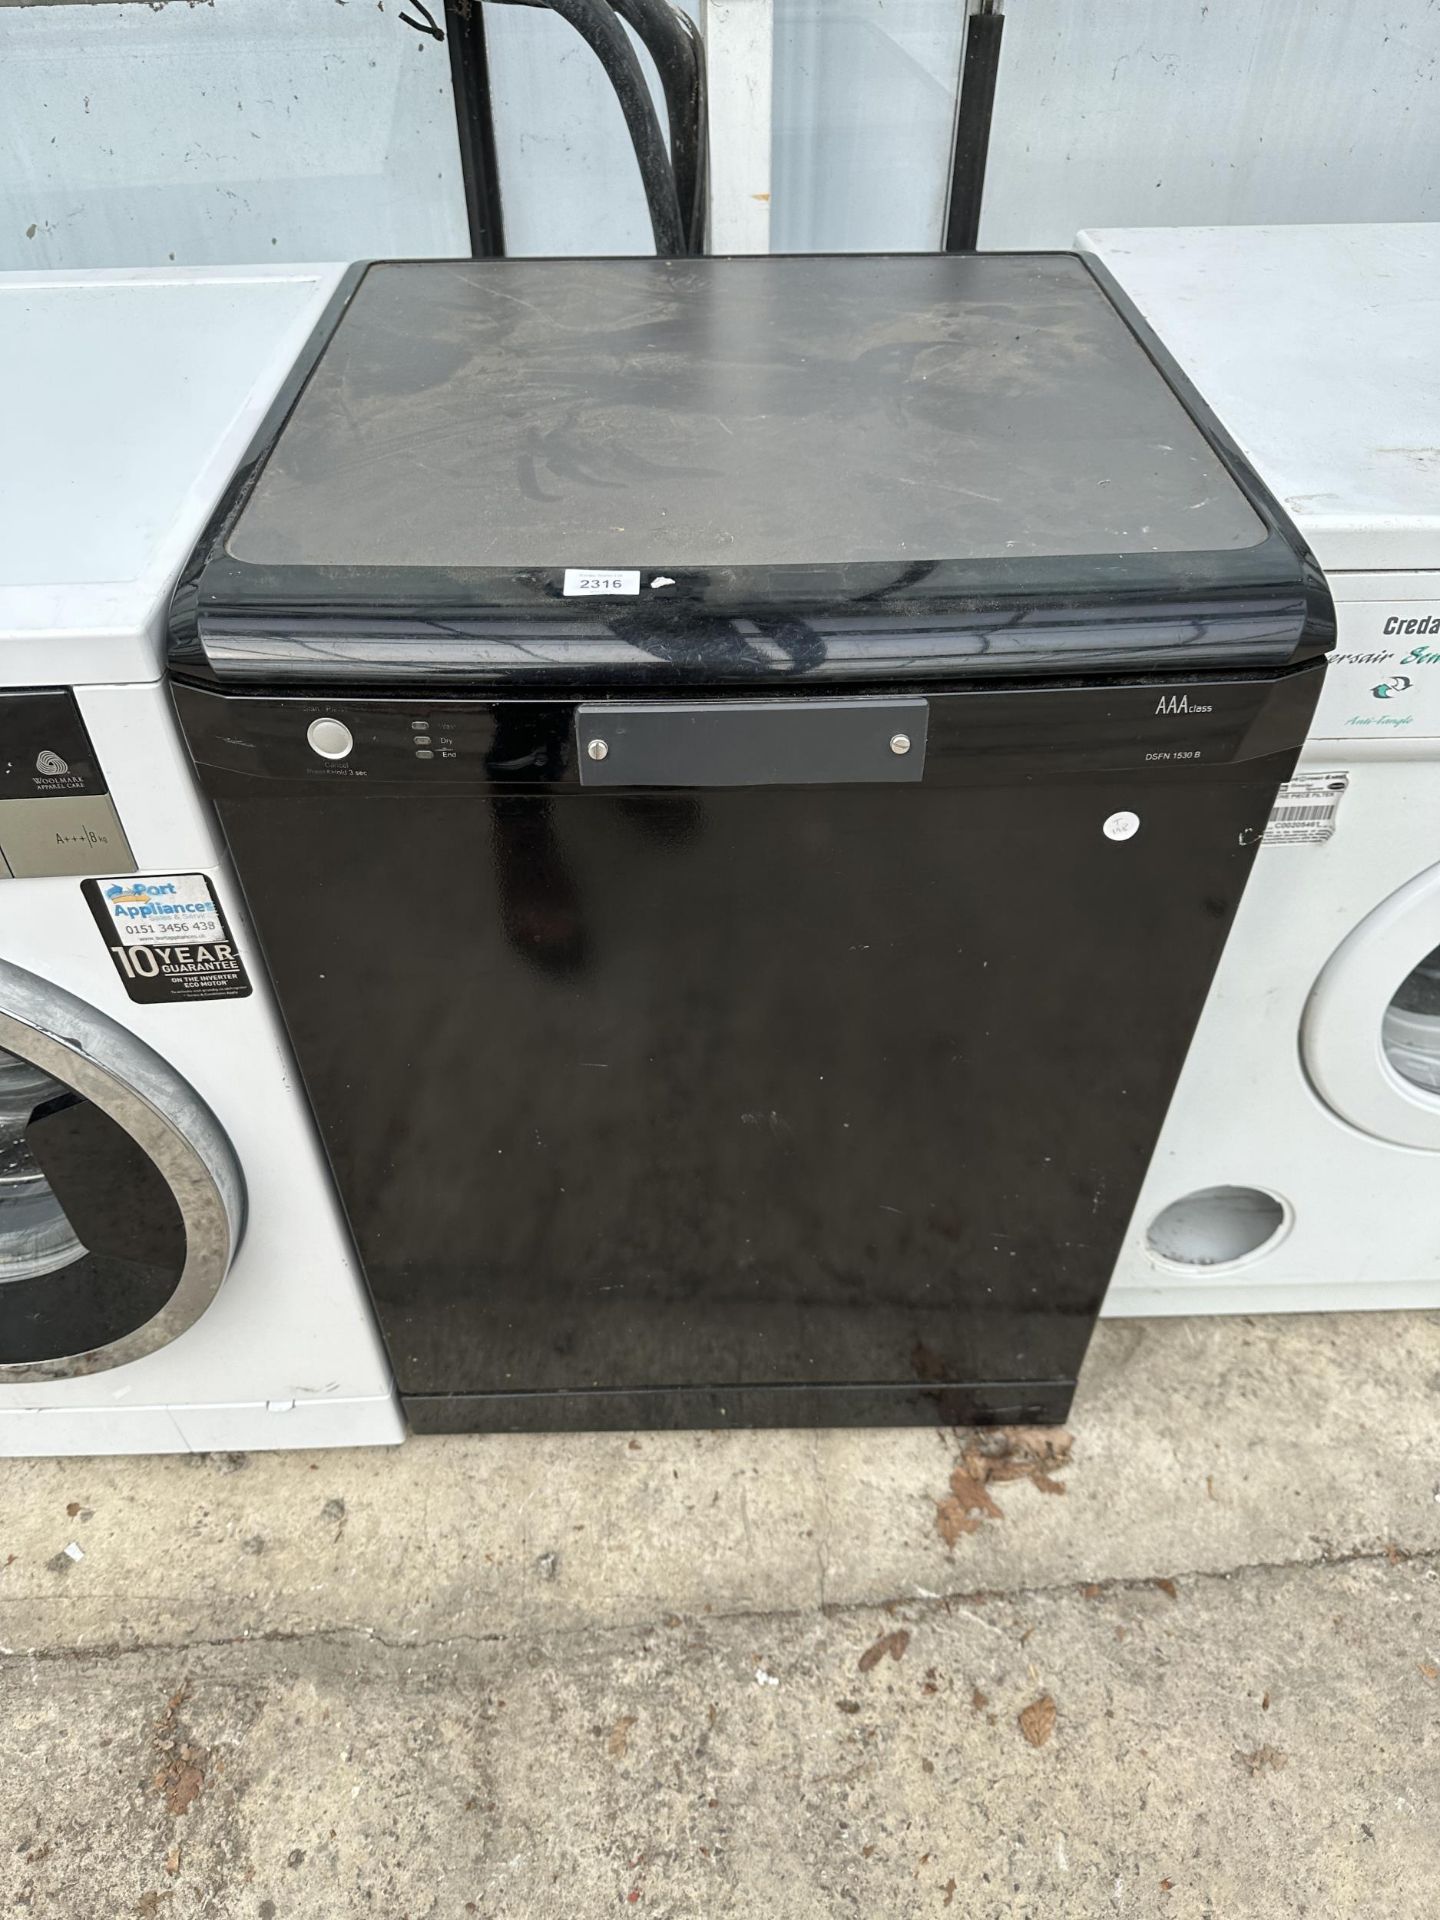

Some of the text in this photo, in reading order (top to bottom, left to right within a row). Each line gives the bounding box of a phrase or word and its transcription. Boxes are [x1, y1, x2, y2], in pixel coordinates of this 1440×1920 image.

[580, 580, 622, 588] 2316
[1383, 616, 1440, 635] Creda
[1328, 650, 1395, 664] ersair
[1173, 751, 1192, 759] 1530
[32, 776, 84, 785] WOOLMARK
[132, 883, 176, 895] Port
[126, 925, 155, 934] 0151
[159, 923, 189, 933] 3456
[110, 944, 235, 978] 10 YEAR
[162, 960, 239, 973] GUARANTEE
[200, 973, 238, 981] INVERTER
